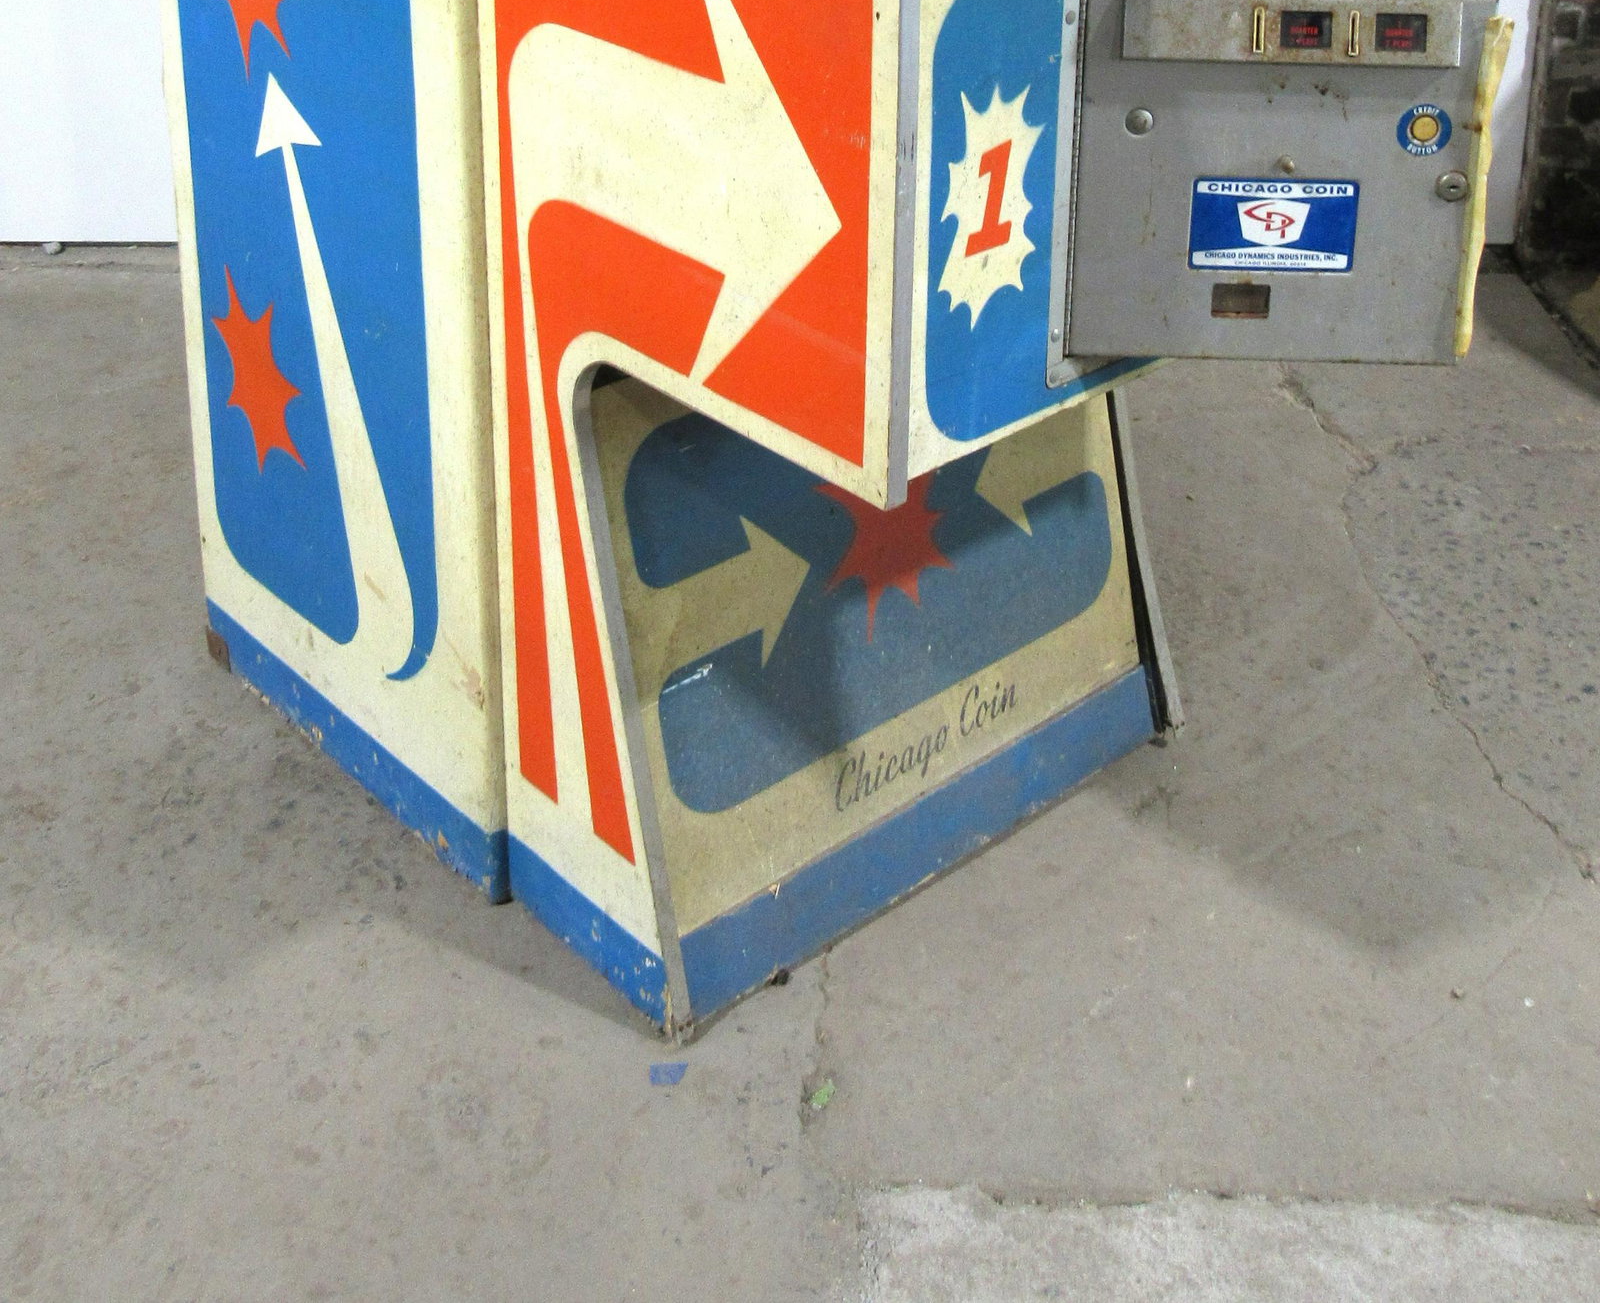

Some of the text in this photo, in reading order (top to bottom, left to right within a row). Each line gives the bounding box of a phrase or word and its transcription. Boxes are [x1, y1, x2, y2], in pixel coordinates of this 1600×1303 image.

[1413, 106, 1439, 115] CREDIT
[1407, 143, 1438, 155] BUTTON
[1207, 182, 1348, 195] CHICAGO COIN
[965, 138, 1012, 258] 1
[1238, 252, 1275, 260] DYNAMICS
[1277, 253, 1322, 262] INDUSTRIES,
[1324, 254, 1338, 262] INC.
[834, 682, 1017, 812] Chicago Coin
